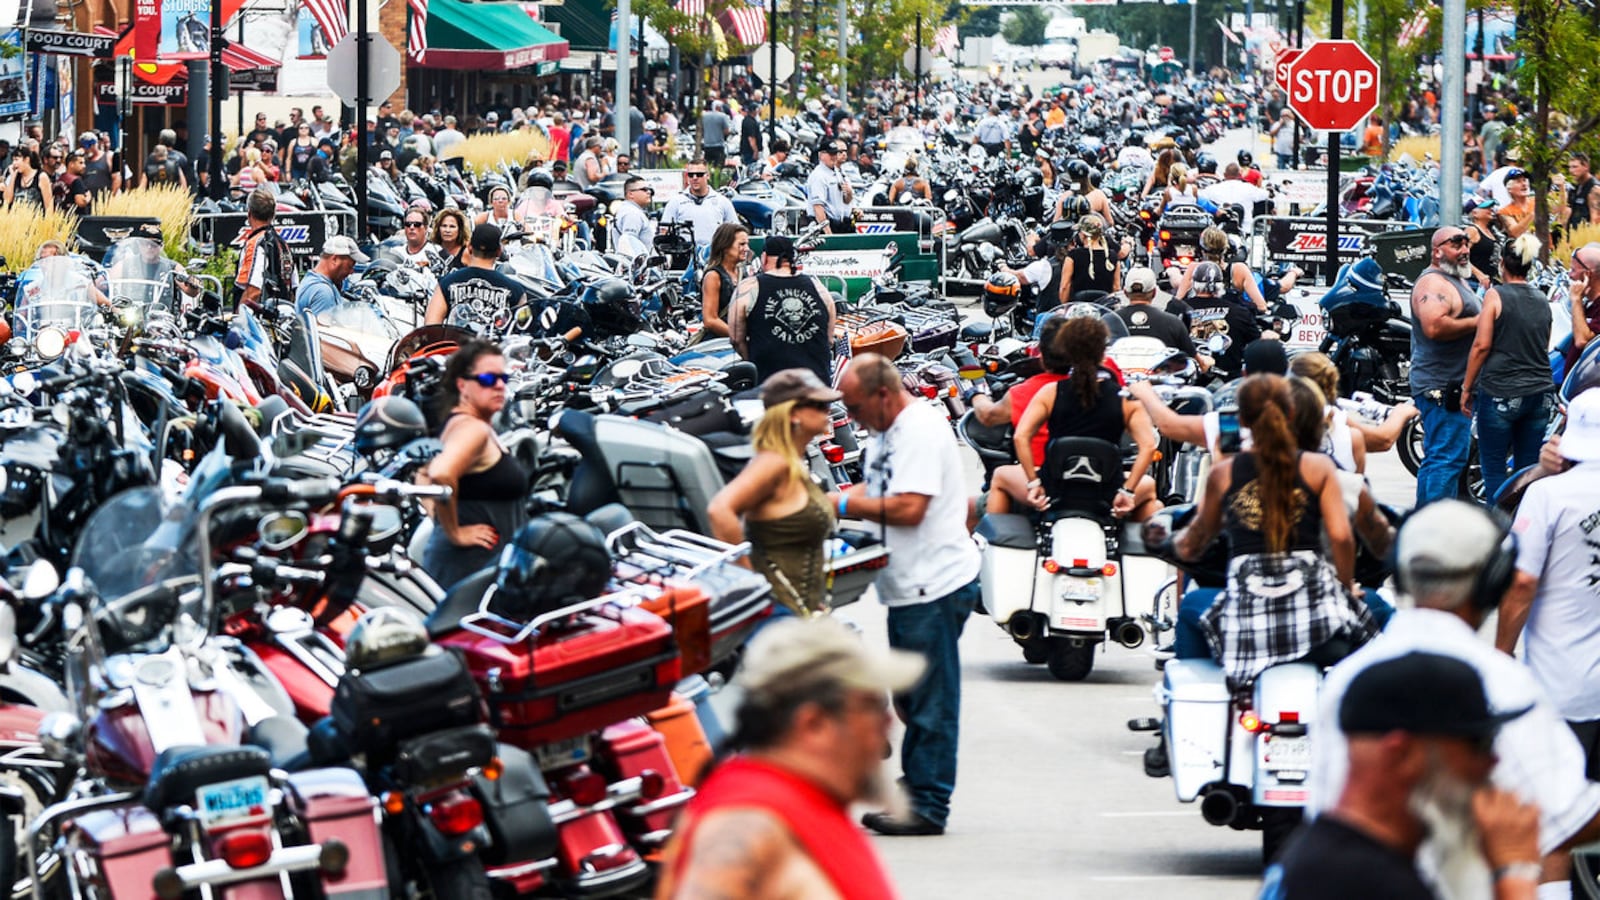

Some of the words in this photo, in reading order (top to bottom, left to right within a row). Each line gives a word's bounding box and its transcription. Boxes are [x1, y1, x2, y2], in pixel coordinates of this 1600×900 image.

[27, 33, 63, 45] FOOD
[66, 36, 112, 49] COURT
[138, 85, 182, 96] COURT
[1294, 69, 1374, 103] STOP
[1287, 233, 1365, 252] AMOIL
[764, 296, 779, 319] THE
[776, 288, 821, 316] KNUCKLE
[771, 323, 820, 344] SALOON
